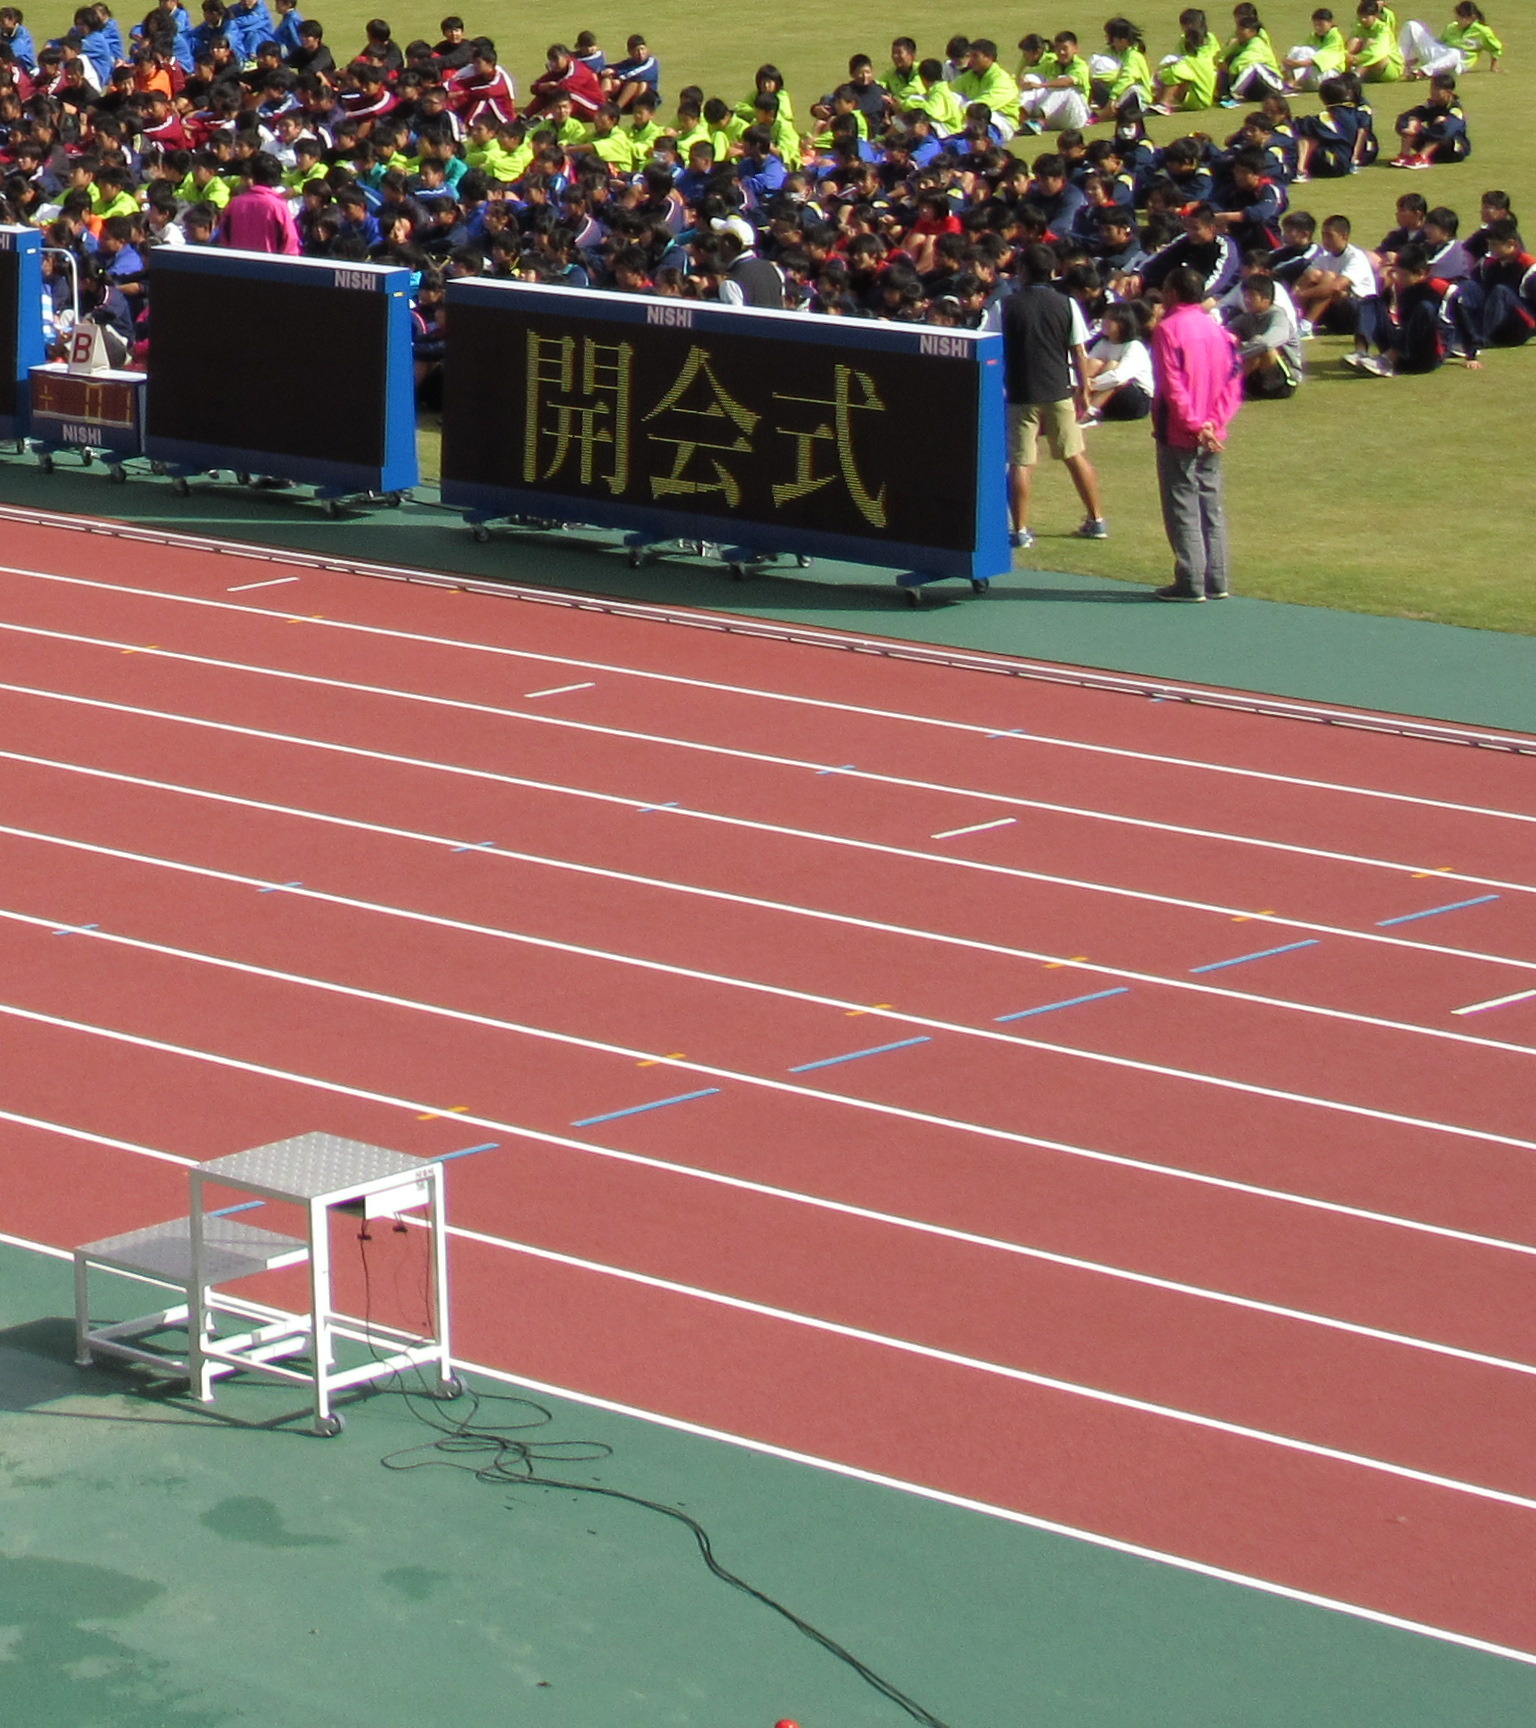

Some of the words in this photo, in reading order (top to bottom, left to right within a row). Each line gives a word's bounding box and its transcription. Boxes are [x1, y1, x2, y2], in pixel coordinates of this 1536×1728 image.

[334, 270, 376, 291] NISHI
[647, 304, 692, 329] NISHI
[72, 332, 93, 364] B
[919, 334, 968, 359] NISHI
[62, 423, 103, 446] NISHI
[523, 328, 888, 530] 開会式
